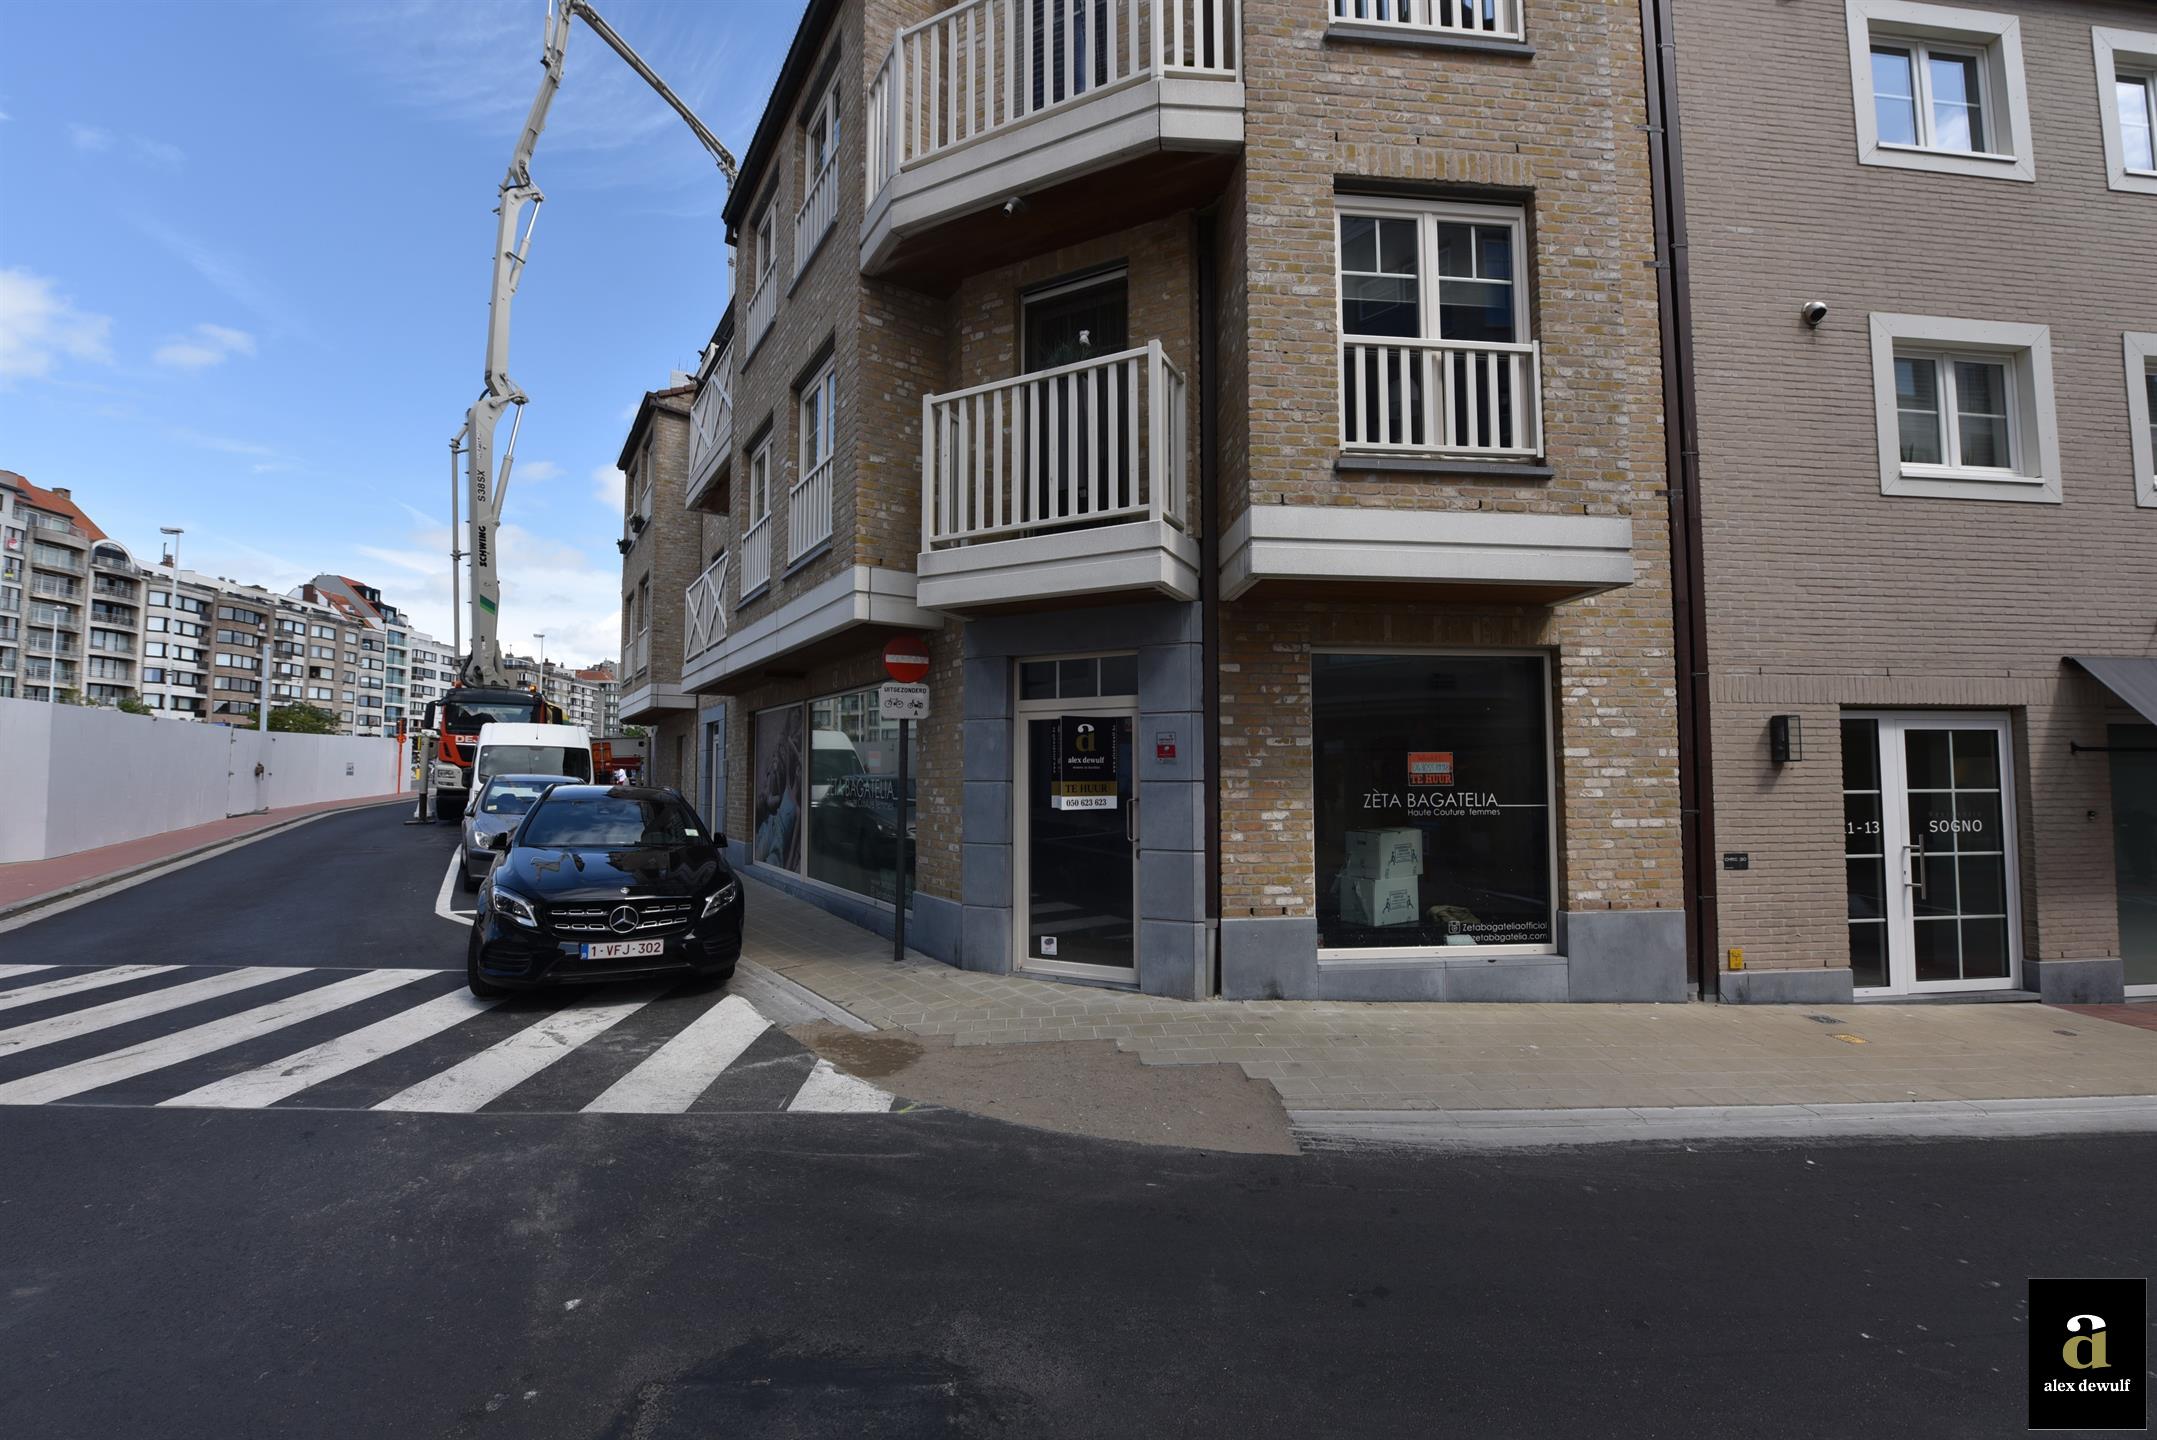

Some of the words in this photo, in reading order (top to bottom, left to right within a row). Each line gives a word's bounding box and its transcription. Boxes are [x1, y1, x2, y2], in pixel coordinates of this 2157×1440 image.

[477, 469, 486, 502] S38SX
[478, 525, 488, 568] SCHWING
[884, 686, 927, 694] UITGEZONDERD
[1410, 773, 1424, 784] TE
[1425, 773, 1452, 784] HUUR
[1065, 784, 1078, 793] TE
[1080, 783, 1107, 793] HUUR
[1066, 799, 1079, 807] 050
[1081, 798, 1093, 807] 623
[1095, 798, 1107, 806] 623
[1363, 788, 1401, 808] ZÈTA
[1407, 792, 1498, 808] BAGATELIA
[1433, 808, 1465, 816] Couture
[1469, 808, 1500, 816] femmes
[1843, 821, 1880, 834] 1-13
[1929, 820, 1982, 833] SOGNO
[591, 942, 661, 957] 1-VFJ-302
